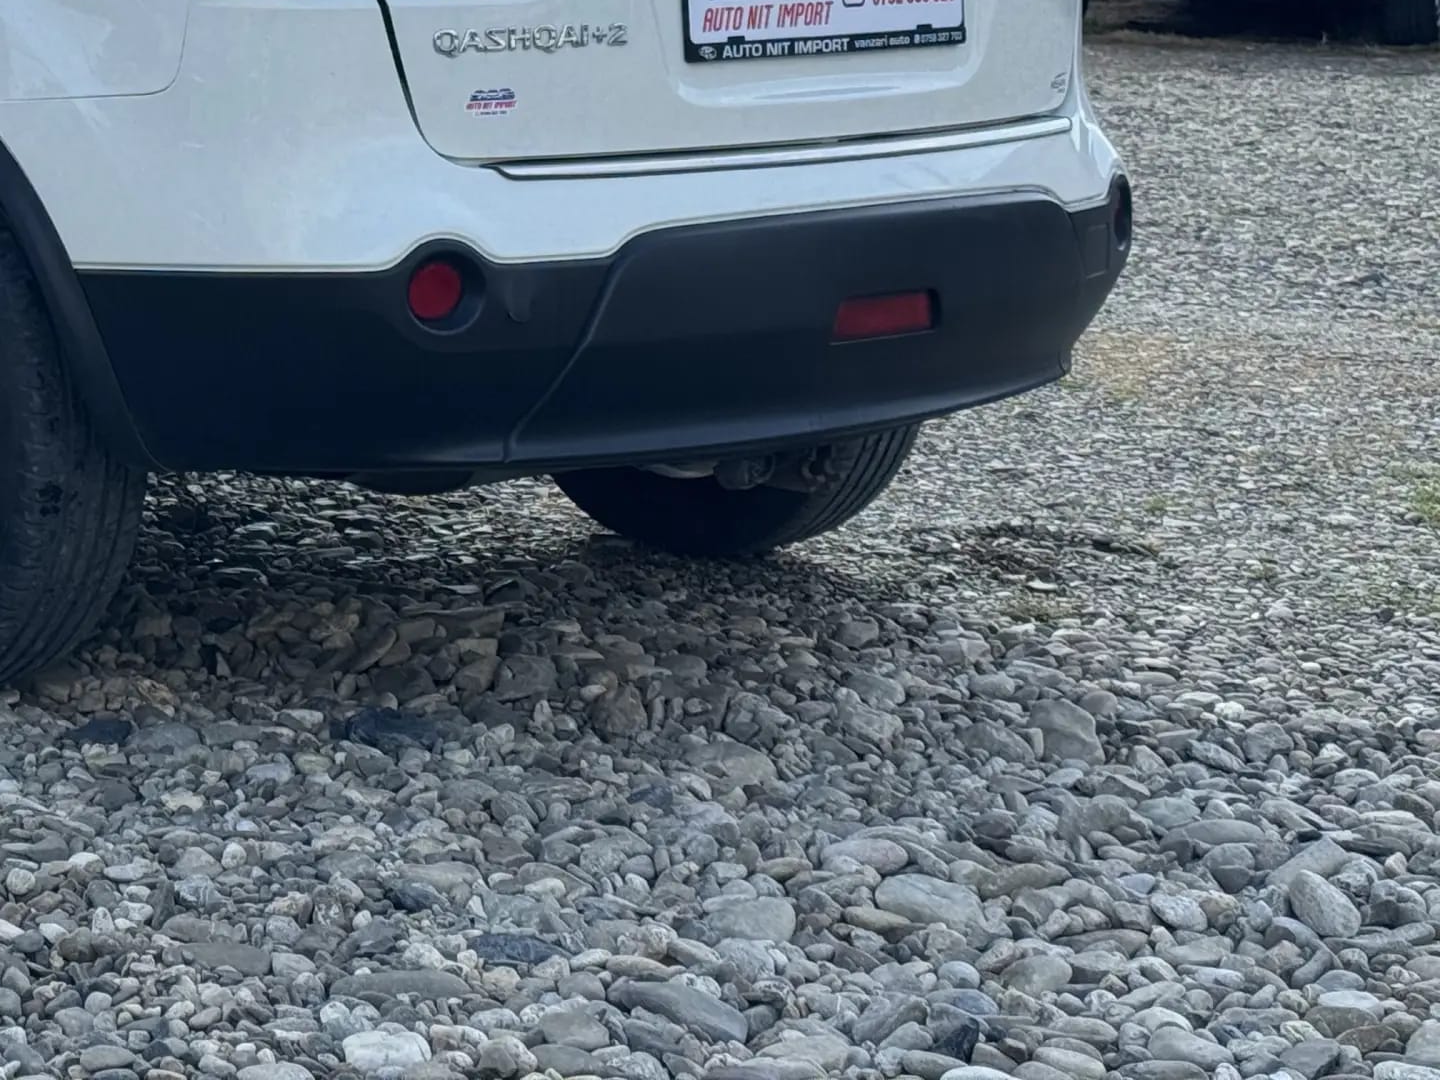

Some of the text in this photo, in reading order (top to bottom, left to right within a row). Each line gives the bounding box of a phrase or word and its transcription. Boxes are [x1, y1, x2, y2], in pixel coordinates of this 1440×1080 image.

[703, 1, 834, 32] AUTO NIT IMPORT
[433, 22, 628, 58] QASHQAI+2
[722, 44, 762, 59] AUTO
[766, 41, 791, 56] NIT
[794, 38, 850, 54] IMPORT
